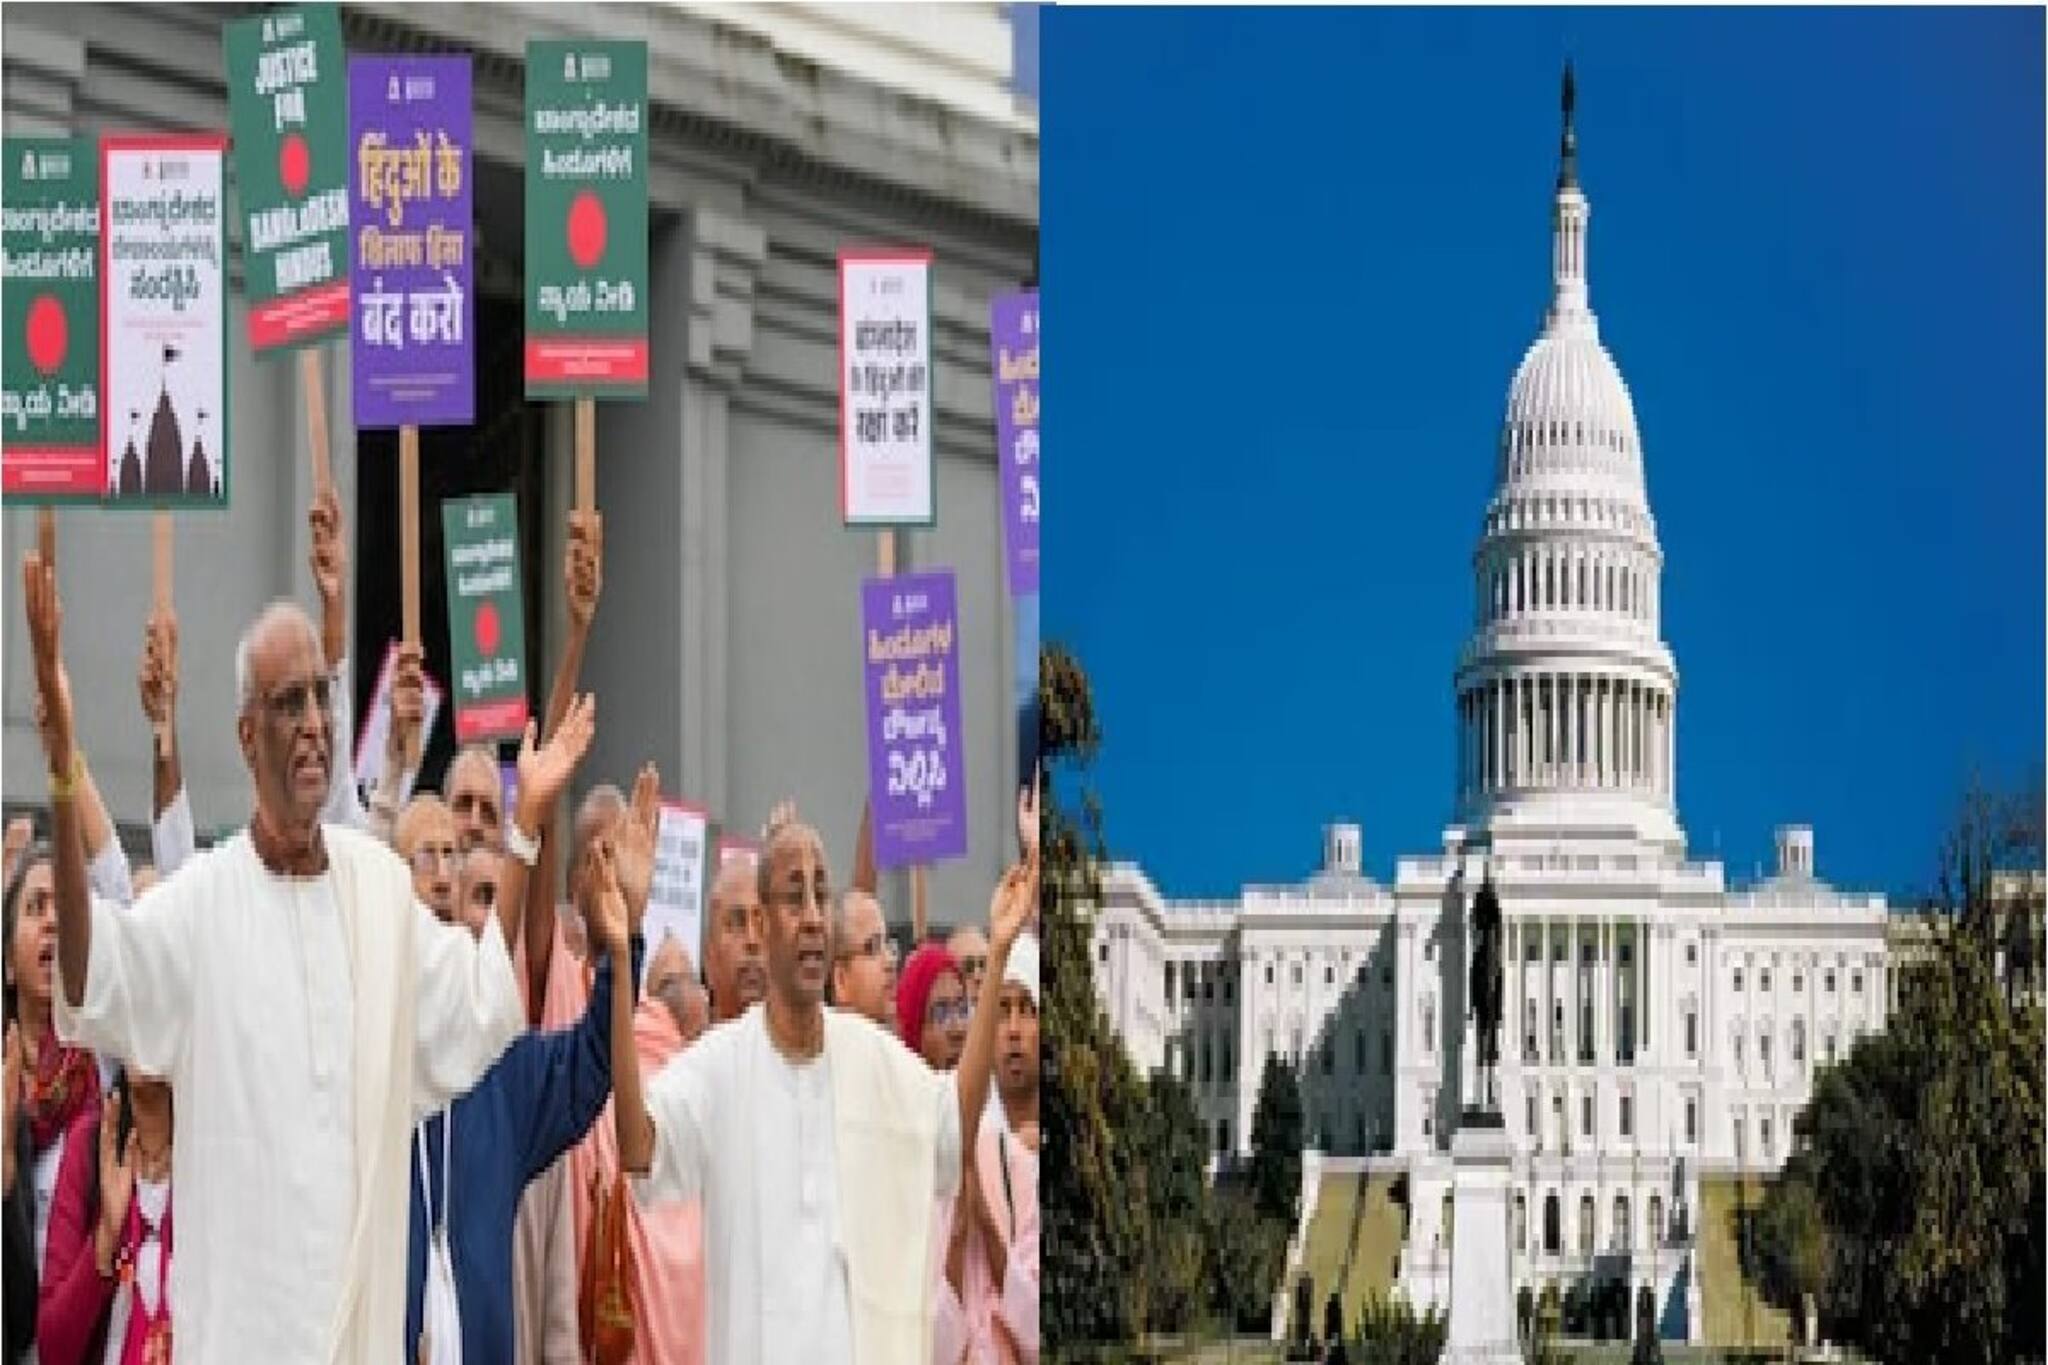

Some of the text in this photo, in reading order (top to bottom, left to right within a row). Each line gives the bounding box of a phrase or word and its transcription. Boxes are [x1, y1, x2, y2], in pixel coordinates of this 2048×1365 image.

[357, 130, 463, 226] हिंदुओं के
[359, 277, 404, 350] बंद
[409, 274, 465, 346] करो
